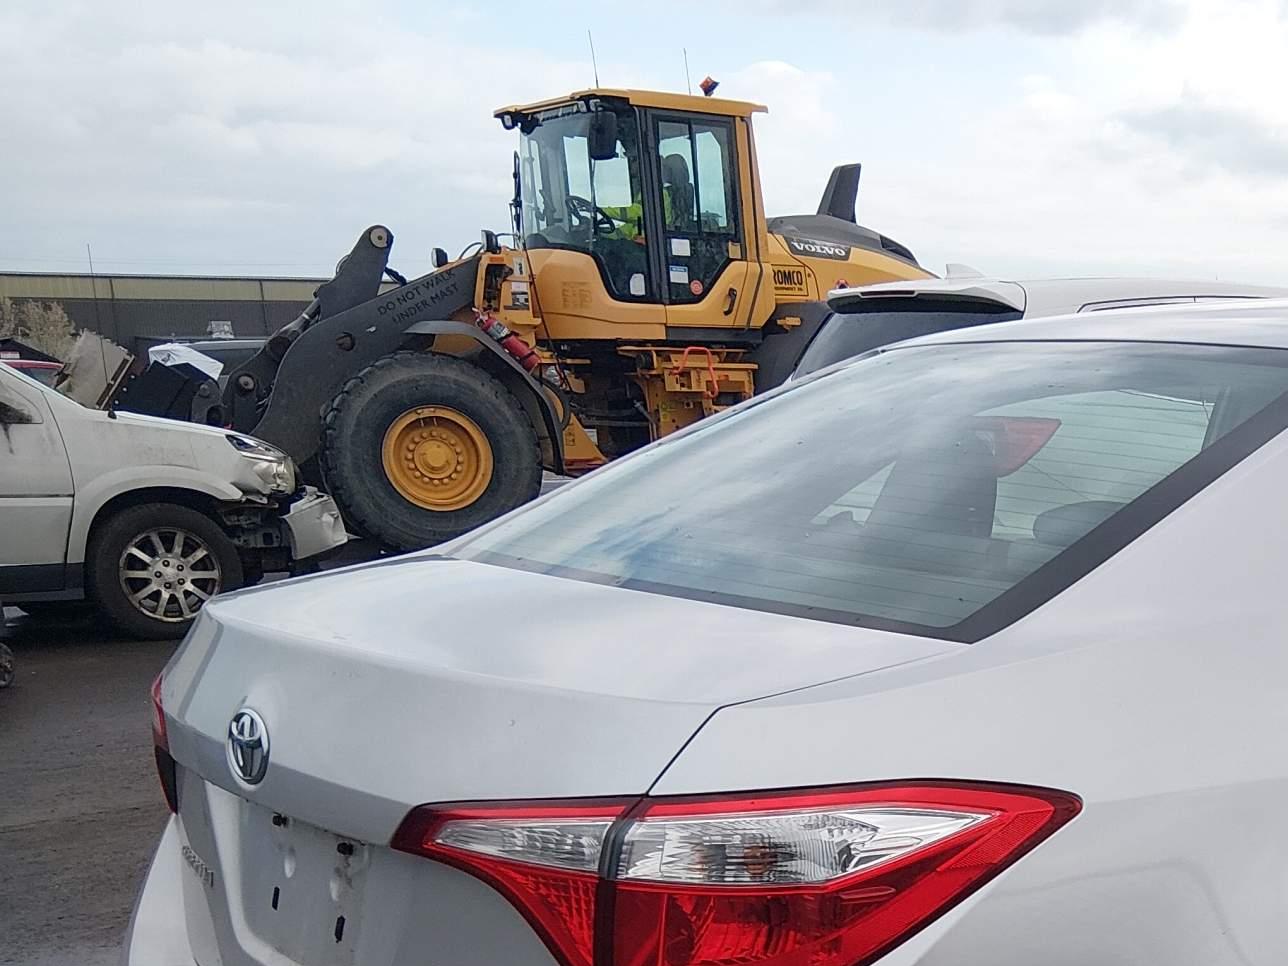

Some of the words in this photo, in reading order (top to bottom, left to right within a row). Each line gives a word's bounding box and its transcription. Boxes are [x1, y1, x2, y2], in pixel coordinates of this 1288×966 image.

[790, 240, 846, 257] VOLVO
[377, 301, 396, 316] DO
[397, 286, 421, 305] NOT
[422, 269, 456, 291] WALK
[391, 299, 431, 324] UNDER
[430, 281, 459, 305] MAST
